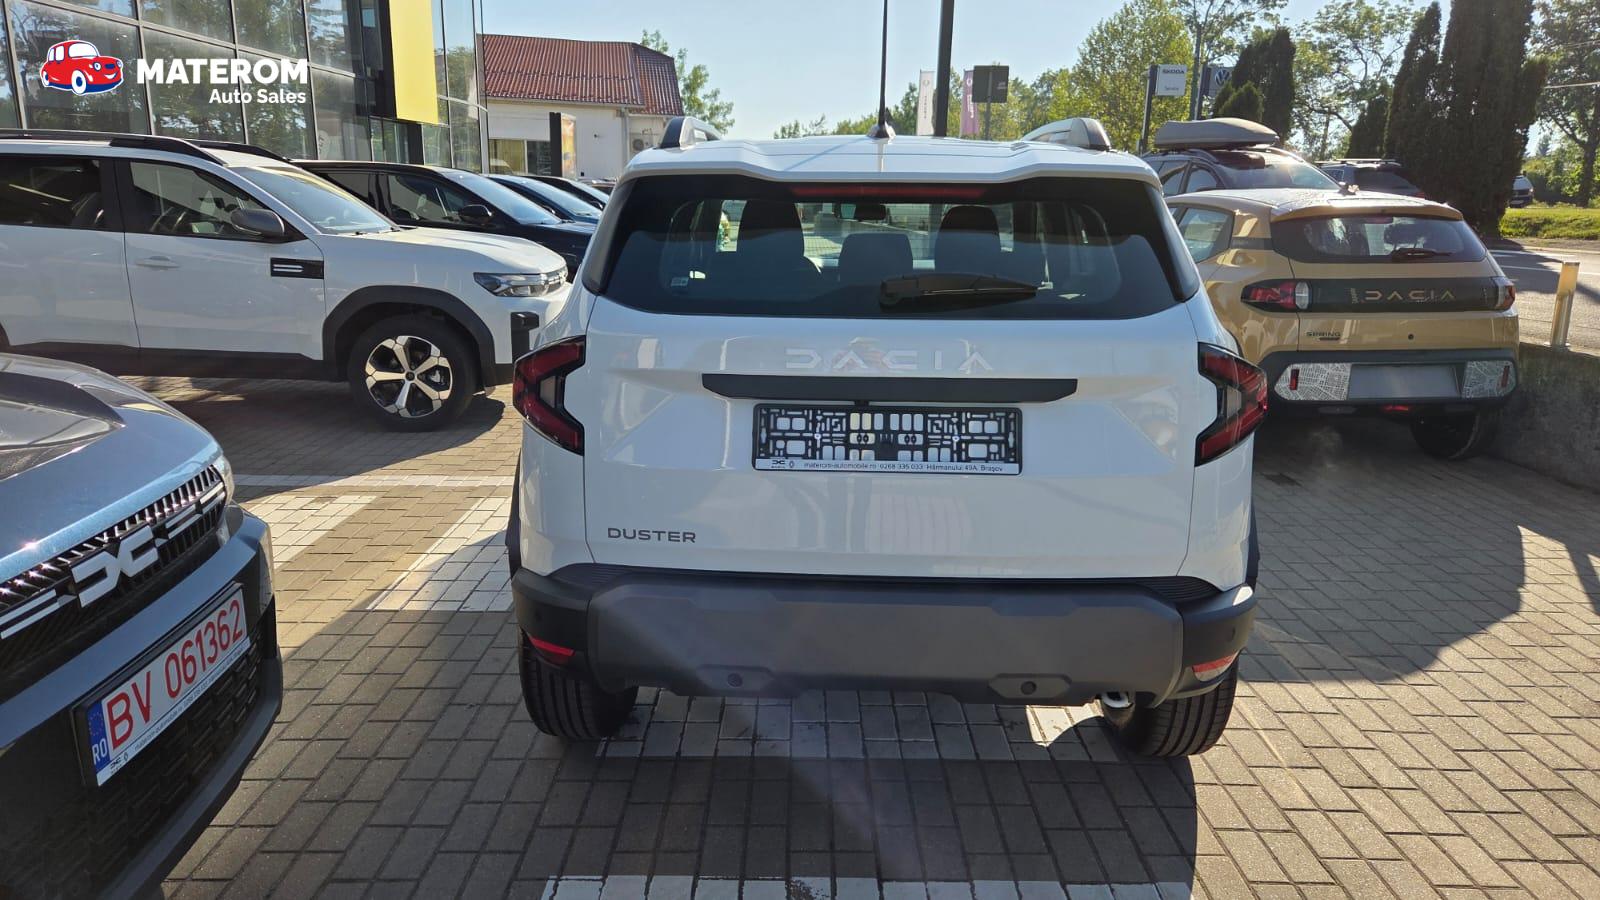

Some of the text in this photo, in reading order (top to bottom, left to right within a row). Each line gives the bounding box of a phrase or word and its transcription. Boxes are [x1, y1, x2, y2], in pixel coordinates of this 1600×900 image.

[1365, 290, 1456, 301] DACIA
[785, 348, 994, 371] DACIA
[607, 527, 697, 543] DUSTER
[106, 671, 151, 750] BV
[164, 599, 243, 699] 061362
[91, 738, 108, 766] RO
